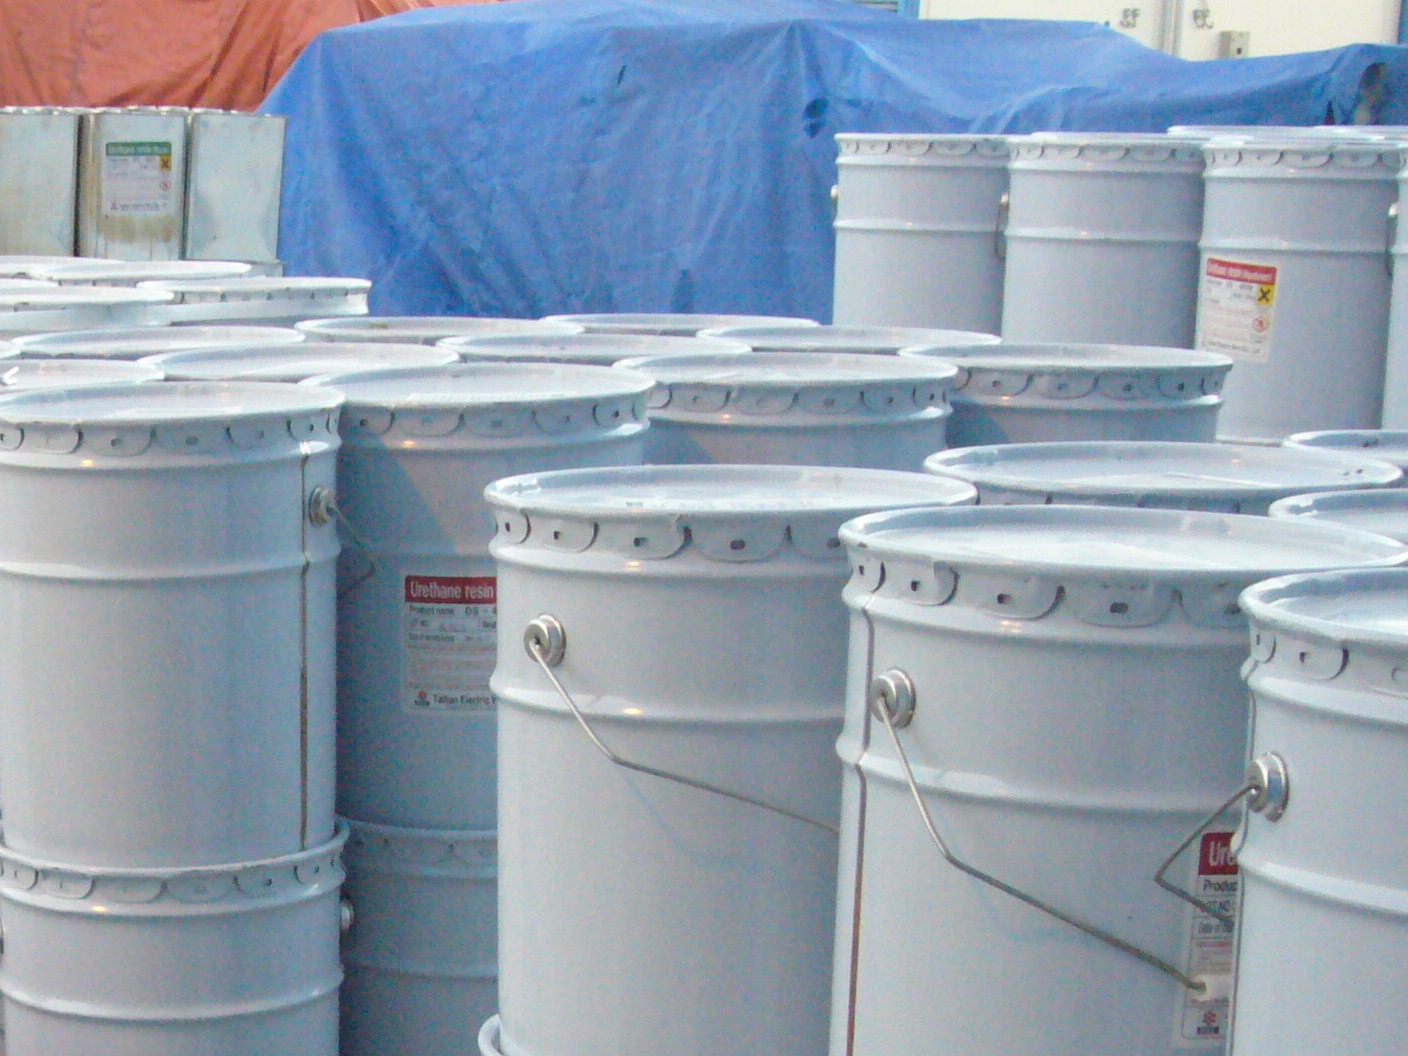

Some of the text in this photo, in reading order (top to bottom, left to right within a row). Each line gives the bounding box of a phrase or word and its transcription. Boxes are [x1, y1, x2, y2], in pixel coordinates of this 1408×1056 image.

[410, 581, 494, 599] Urethane resin
[1203, 879, 1238, 892] Produc
